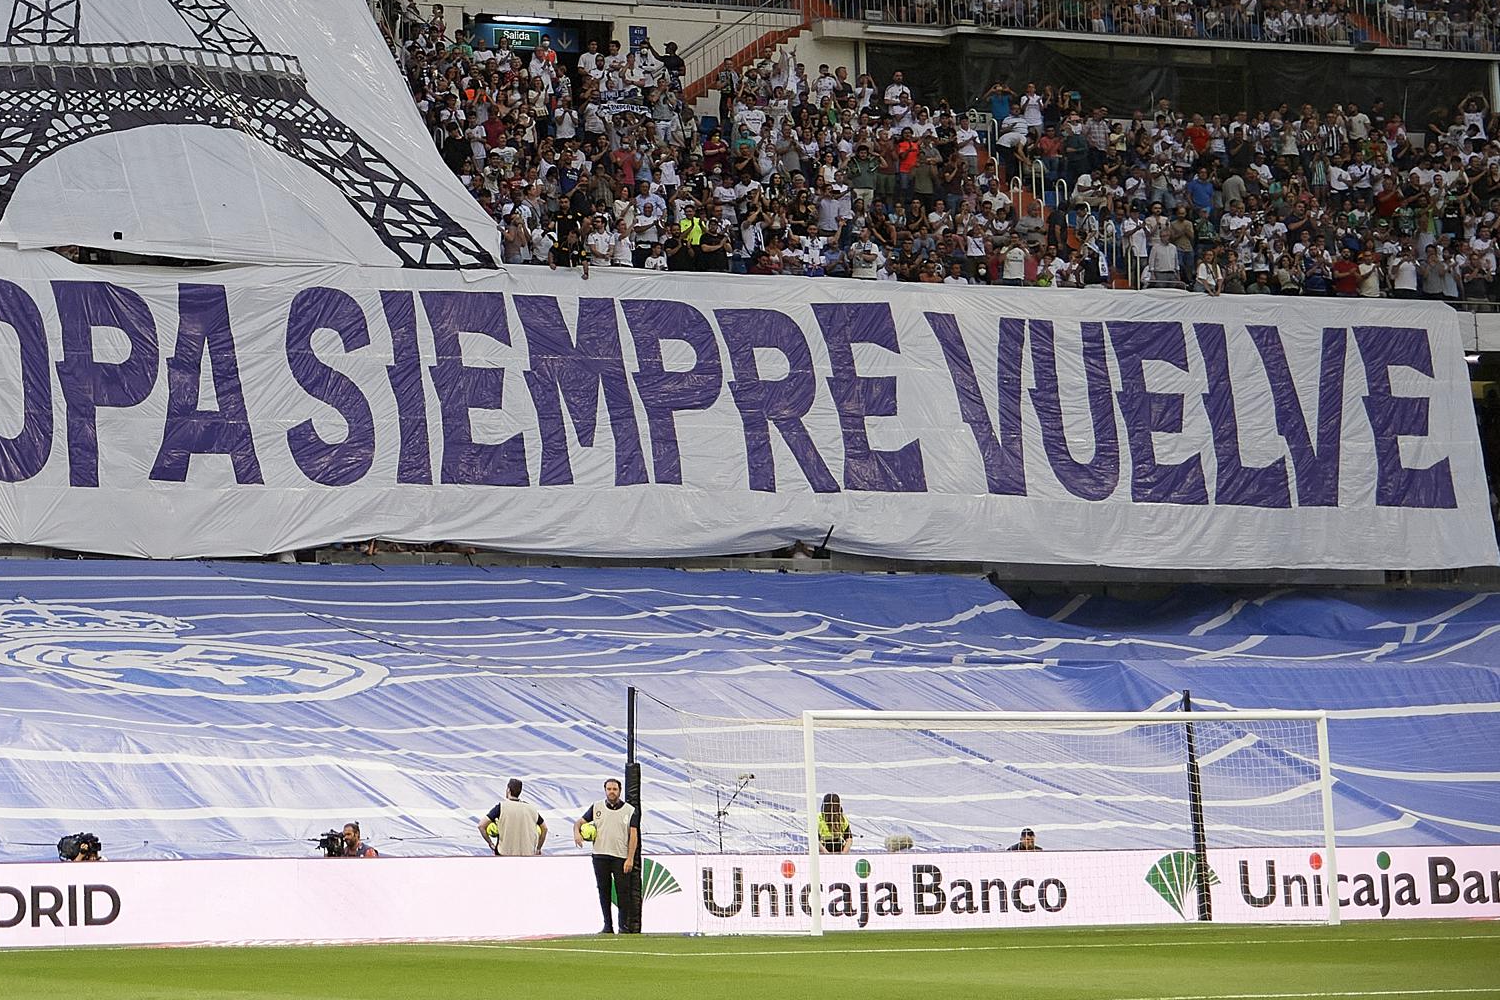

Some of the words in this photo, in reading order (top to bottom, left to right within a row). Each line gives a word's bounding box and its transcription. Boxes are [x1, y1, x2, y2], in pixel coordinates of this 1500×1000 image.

[503, 30, 530, 42] Salida
[286, 287, 926, 492] SIEMPRE
[927, 312, 1457, 509] VUELVE
[702, 859, 904, 928] Unicaja
[913, 864, 1068, 916] Banco
